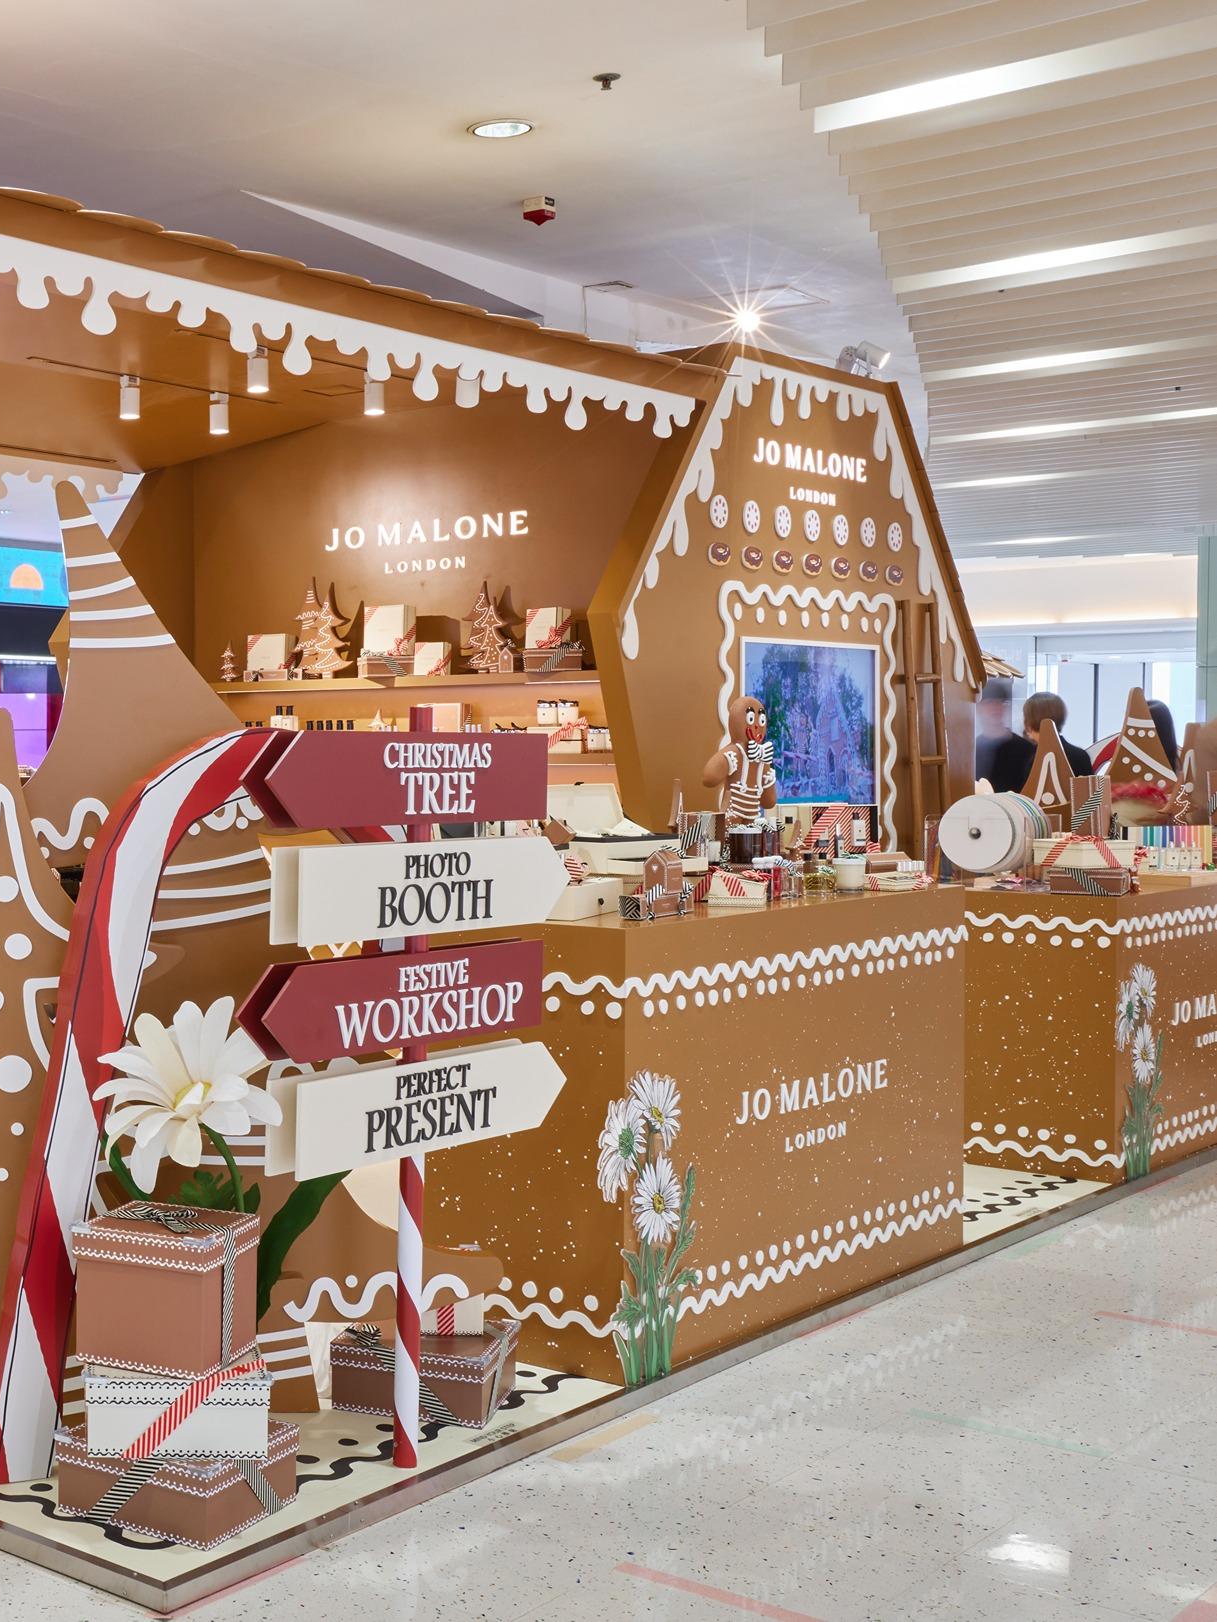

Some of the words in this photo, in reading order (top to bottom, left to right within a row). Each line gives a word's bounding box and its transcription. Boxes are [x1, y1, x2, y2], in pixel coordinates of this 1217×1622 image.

[753, 437, 781, 466] JO
[785, 443, 867, 483] MALONE
[789, 486, 837, 506] LONDON
[325, 525, 366, 552] JO
[377, 509, 530, 547] MALONE
[384, 555, 467, 575] LONDON
[383, 741, 492, 769] CHRISTMAS
[400, 770, 476, 816] TREE
[404, 851, 471, 880] PHOTO
[377, 878, 494, 929] BOOTH
[398, 957, 470, 993] FESTIVE
[334, 981, 525, 1050] WORKSHOP
[1170, 1000, 1192, 1026] JO
[395, 1062, 471, 1101] PERFECT
[736, 1088, 772, 1125] JO
[779, 1059, 888, 1115] MALONE
[364, 1086, 497, 1154] PRESENT
[785, 1121, 847, 1153] LONDON
